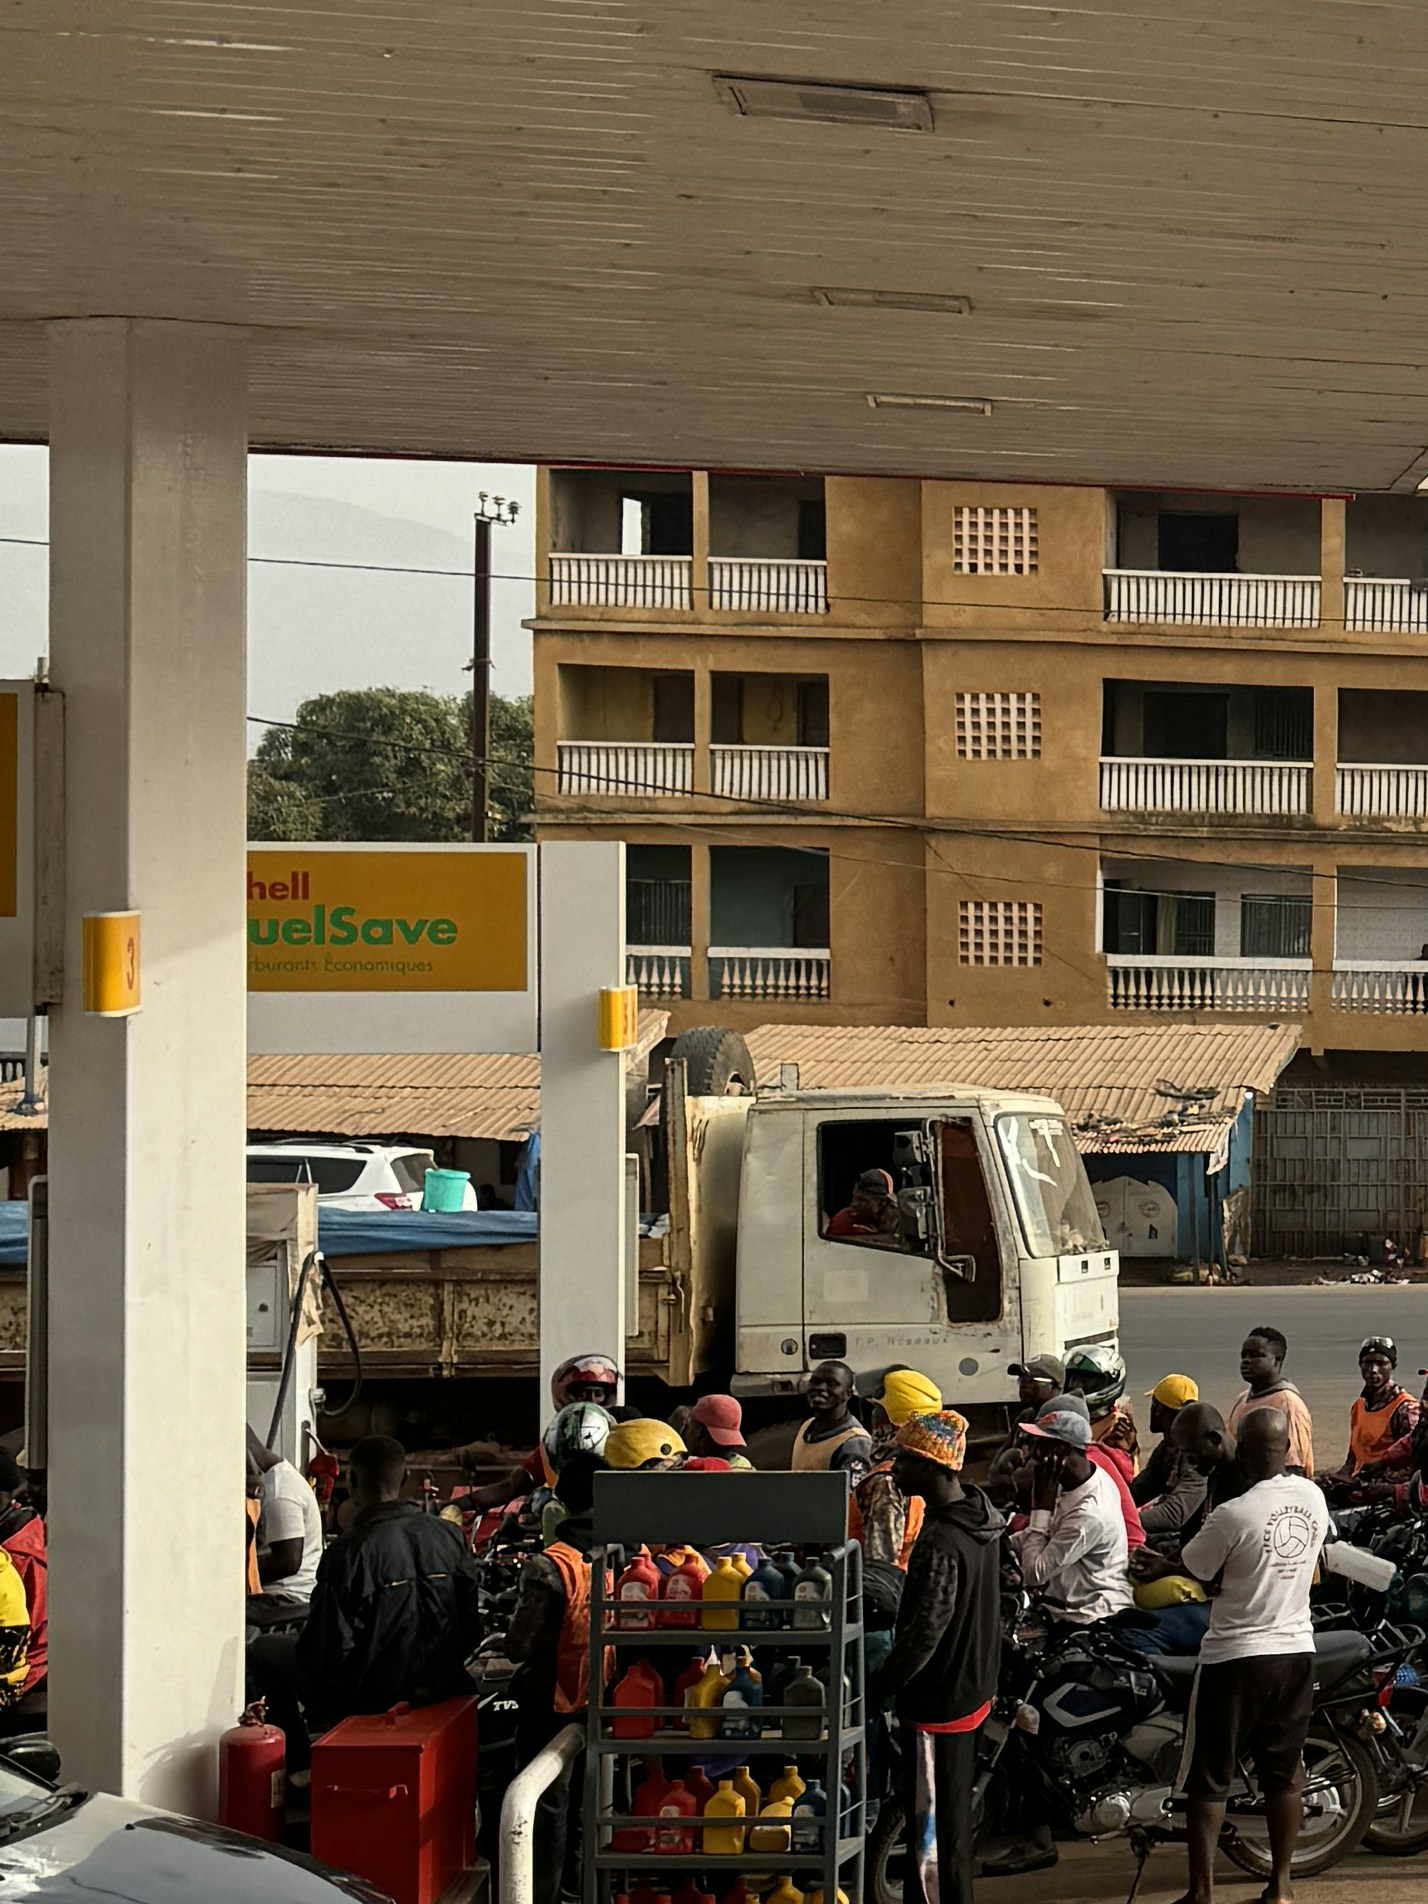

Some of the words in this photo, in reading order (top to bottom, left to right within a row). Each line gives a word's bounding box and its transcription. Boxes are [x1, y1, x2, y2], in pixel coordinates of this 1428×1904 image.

[247, 871, 310, 901] hell
[247, 904, 459, 946] uelSave
[126, 936, 136, 991] 3
[323, 952, 434, 975] Économiques
